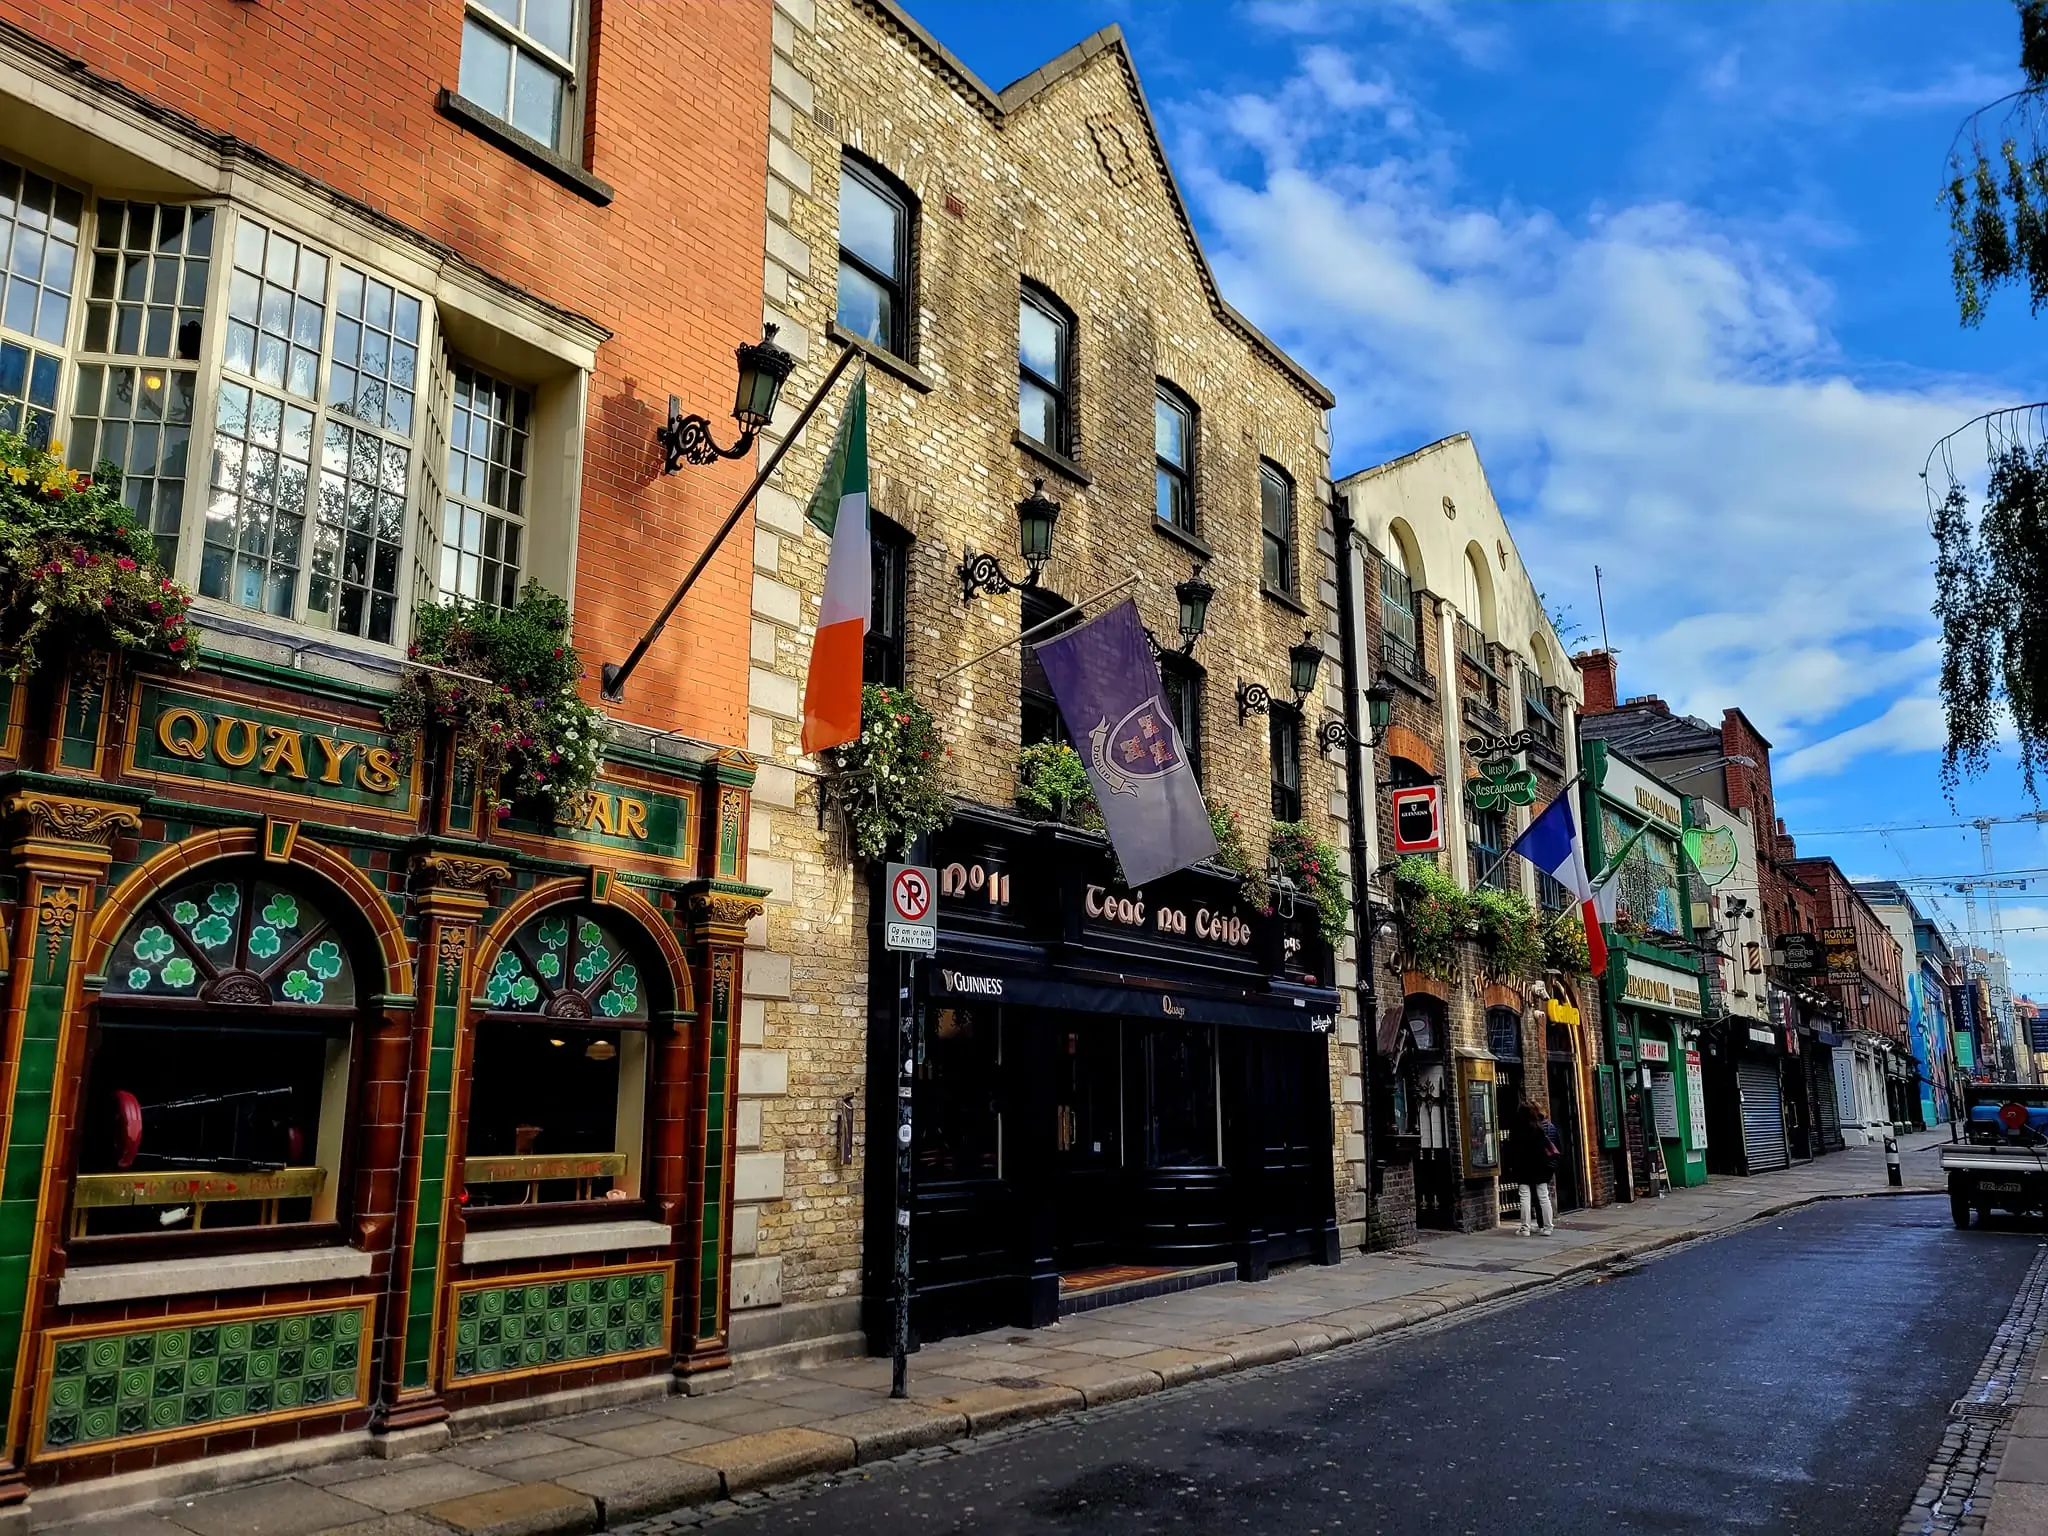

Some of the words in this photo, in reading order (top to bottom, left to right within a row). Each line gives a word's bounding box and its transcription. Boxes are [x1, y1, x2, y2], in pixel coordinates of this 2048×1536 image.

[1465, 733, 1532, 753] Quays
[1157, 907, 1187, 934] na
[954, 971, 1003, 995] GUINNESS
[1961, 994, 1970, 1027] MORGAN
